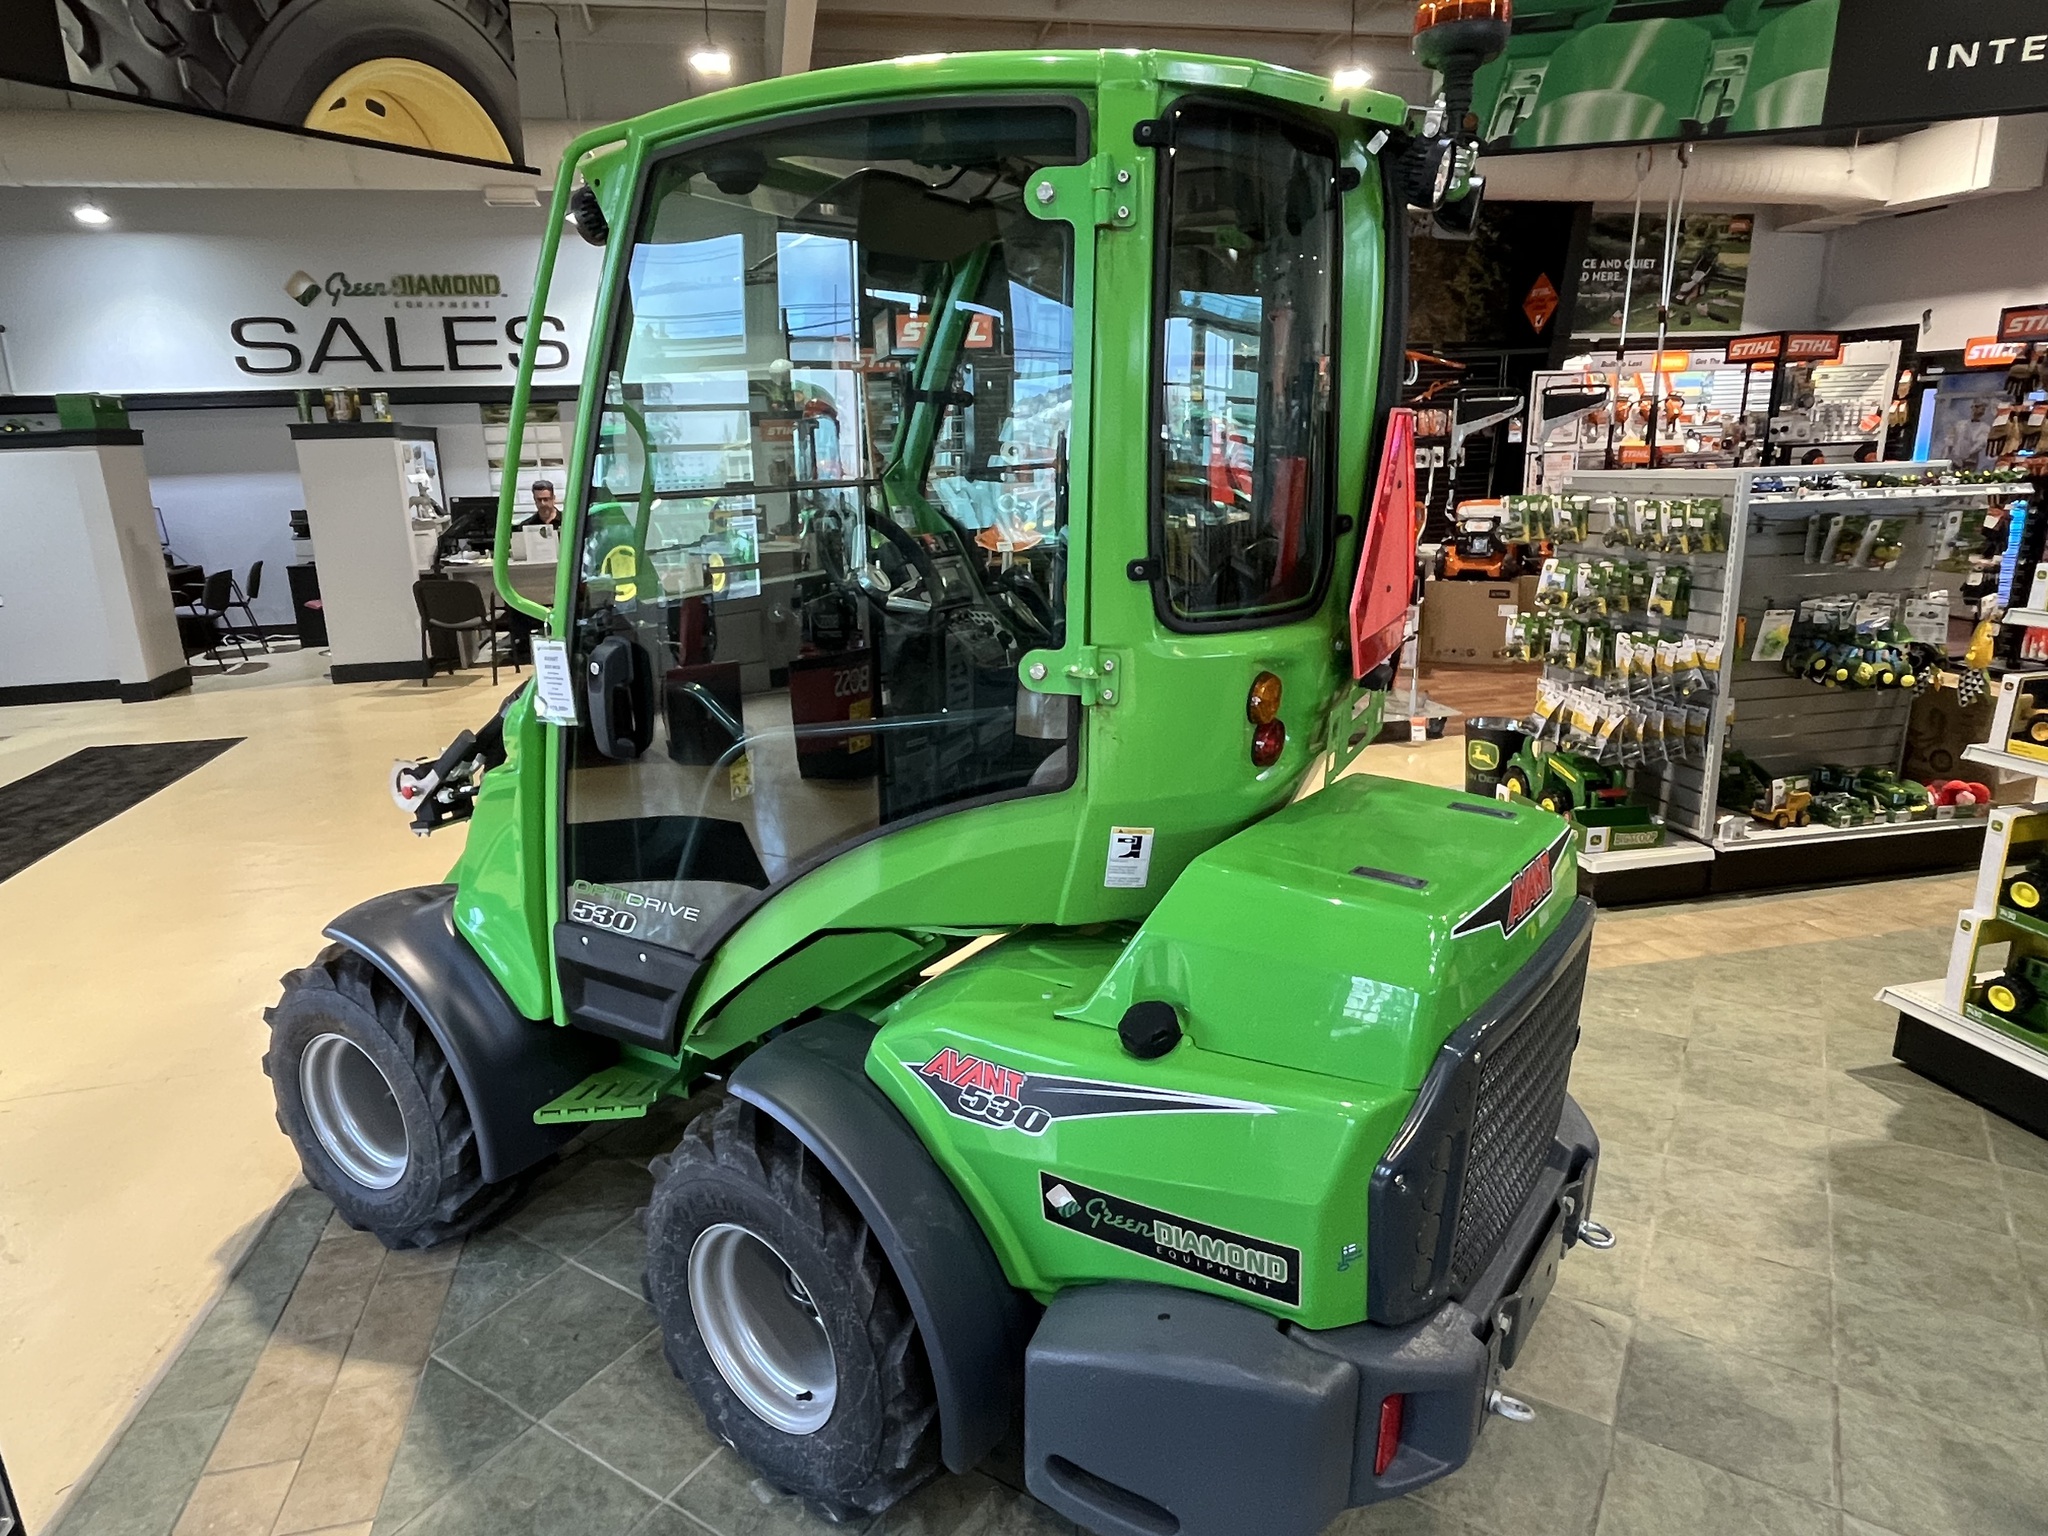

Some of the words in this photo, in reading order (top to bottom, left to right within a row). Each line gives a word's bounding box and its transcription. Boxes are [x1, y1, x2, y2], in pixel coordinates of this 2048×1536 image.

[1599, 258, 1622, 269] AND
[1624, 258, 1656, 271] QUIET
[326, 272, 386, 307] Green
[391, 274, 501, 297] DIAMOND
[231, 316, 569, 374] SALES
[1731, 341, 1779, 357] STIHL
[1787, 338, 1834, 353] STIHL
[1505, 848, 1552, 932] AVANT
[571, 899, 637, 933] 530
[921, 1047, 1025, 1100] AVANT
[957, 1084, 1052, 1137] 530
[1085, 1197, 1157, 1238] Green
[1153, 1220, 1288, 1283] DIAMOND
[1156, 1245, 1273, 1290] EQUIPMENT
